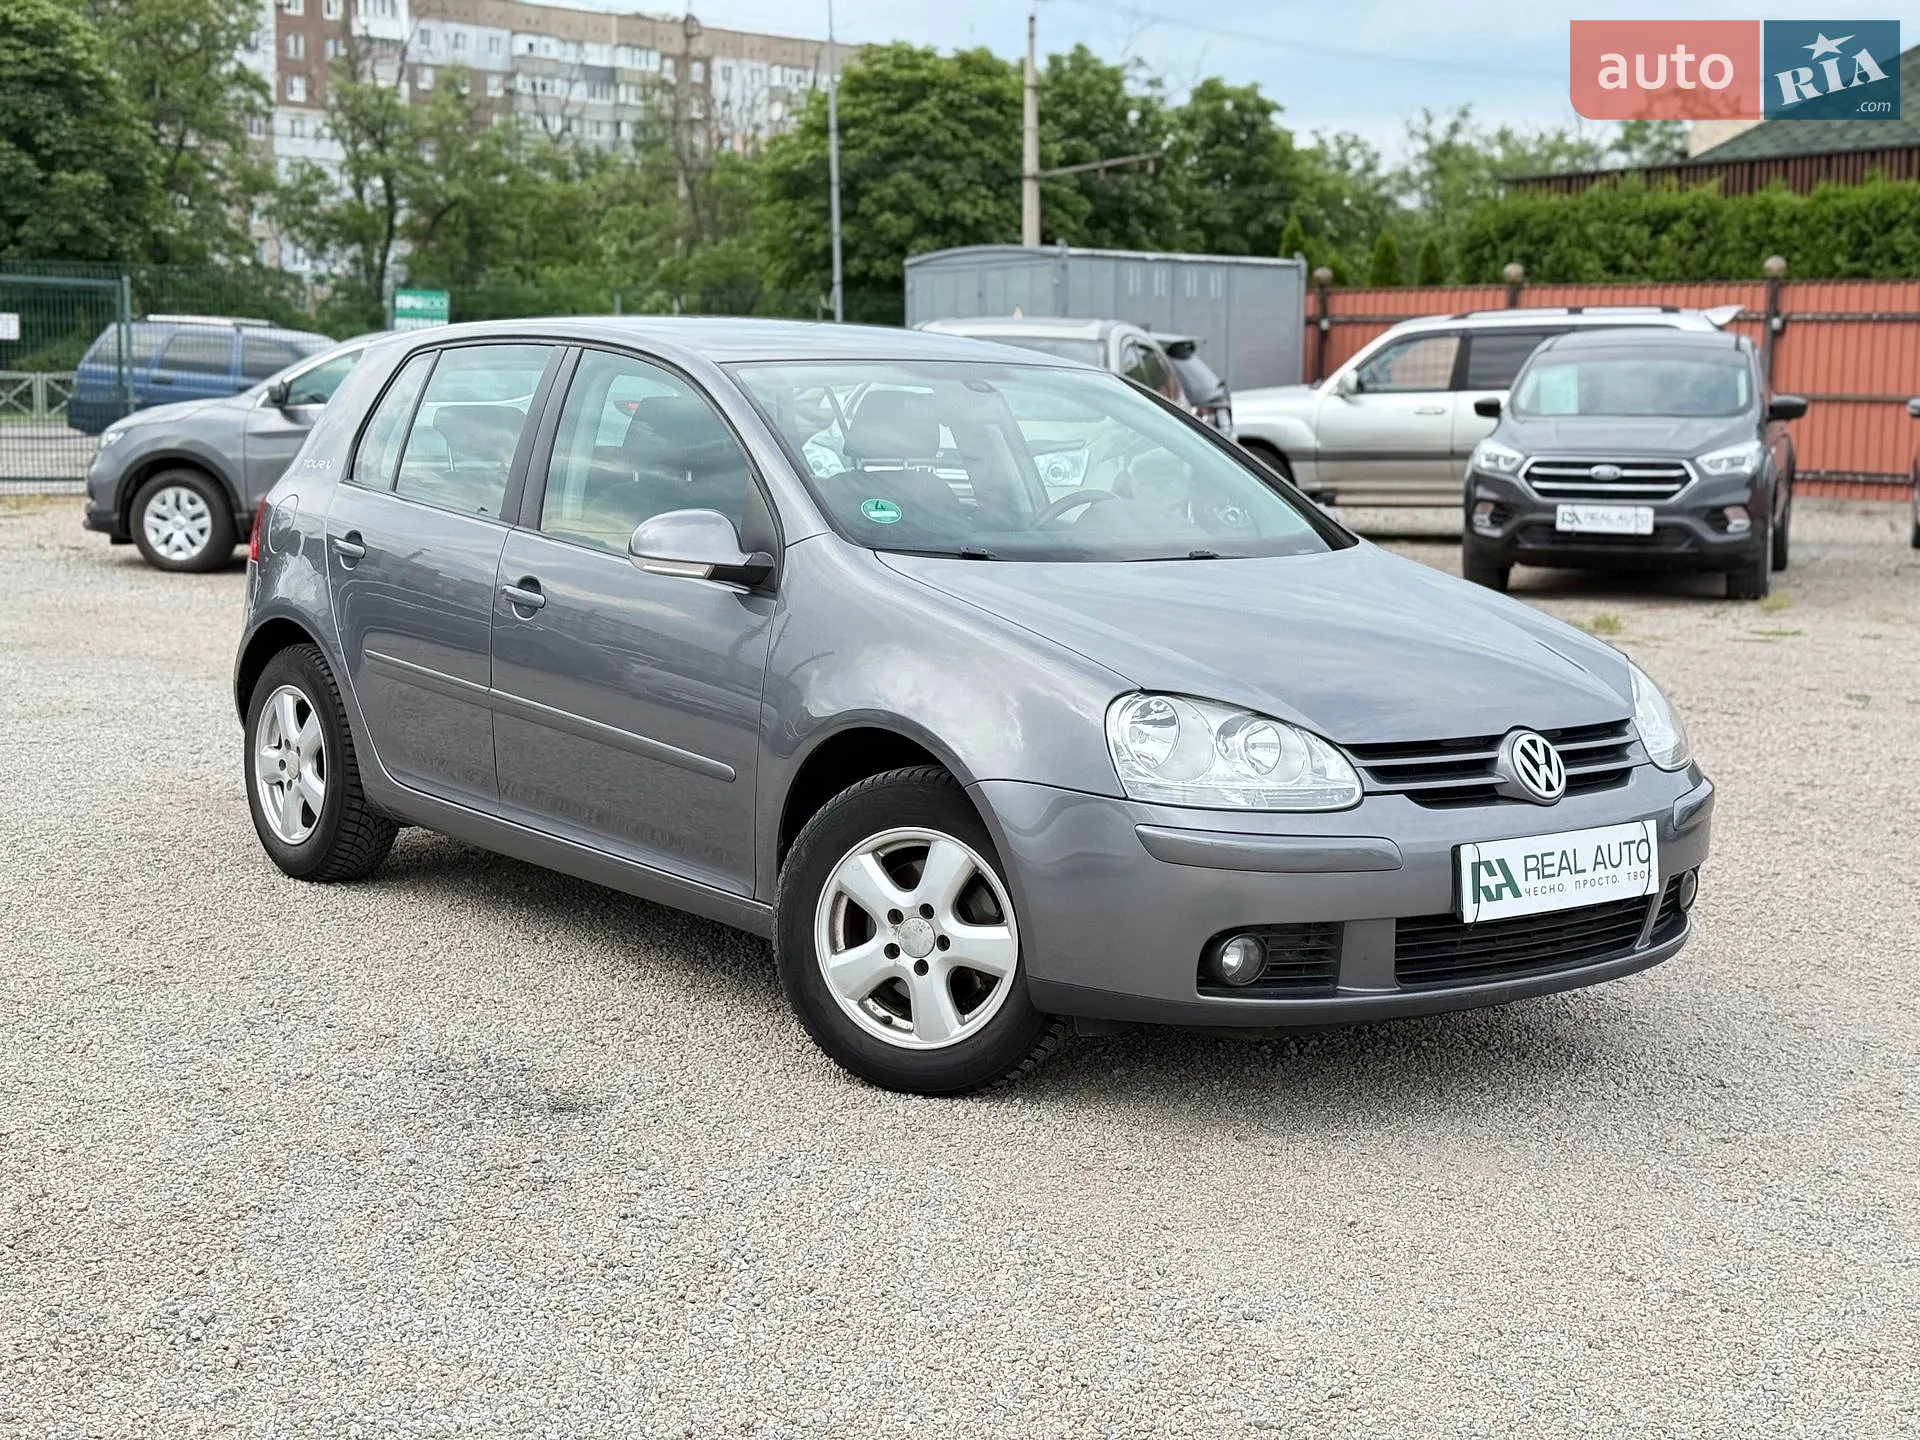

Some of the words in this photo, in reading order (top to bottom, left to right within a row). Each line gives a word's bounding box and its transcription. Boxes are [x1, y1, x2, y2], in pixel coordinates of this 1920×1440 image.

[874, 500, 886, 511] 4
[1523, 848, 1587, 882] REAL
[1592, 838, 1651, 872] AUTO
[1524, 882, 1567, 897] ЧЕСНО.
[1574, 874, 1620, 889] ПРОСТО.
